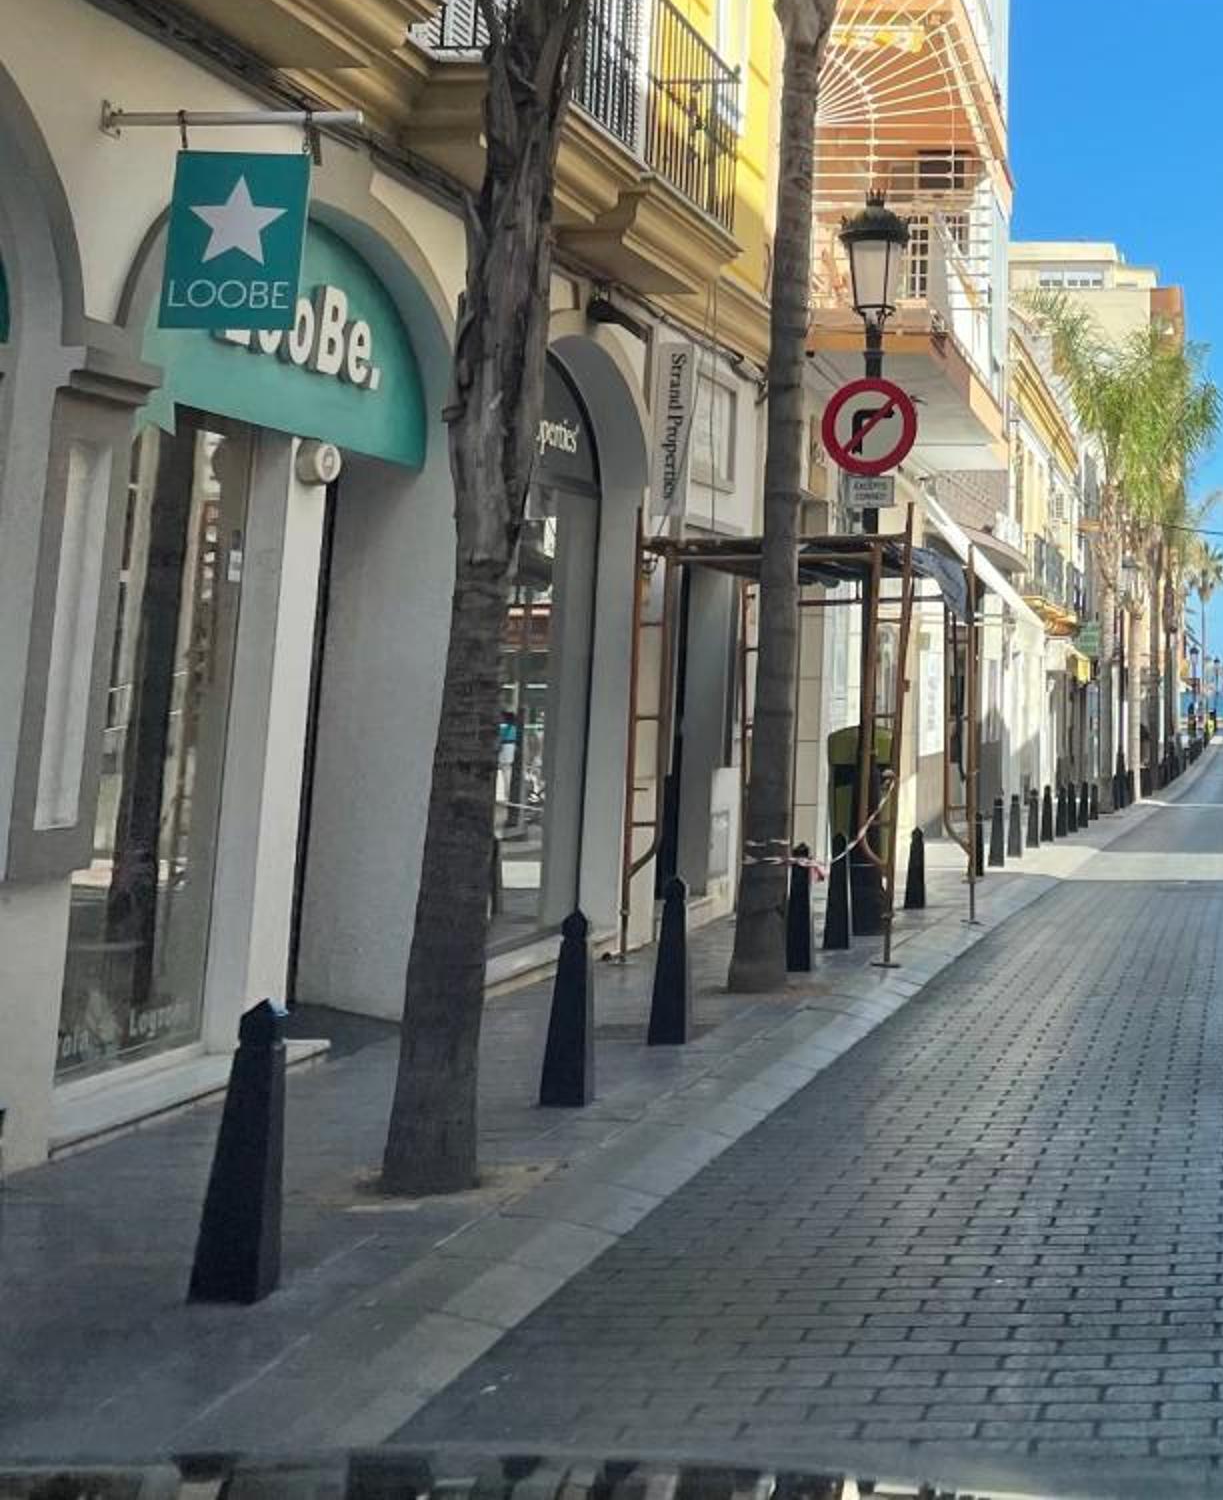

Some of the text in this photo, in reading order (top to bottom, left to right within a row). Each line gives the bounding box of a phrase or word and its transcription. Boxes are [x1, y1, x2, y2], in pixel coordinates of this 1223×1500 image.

[167, 279, 289, 309] LOOBE
[661, 352, 687, 499] Strand Properties
